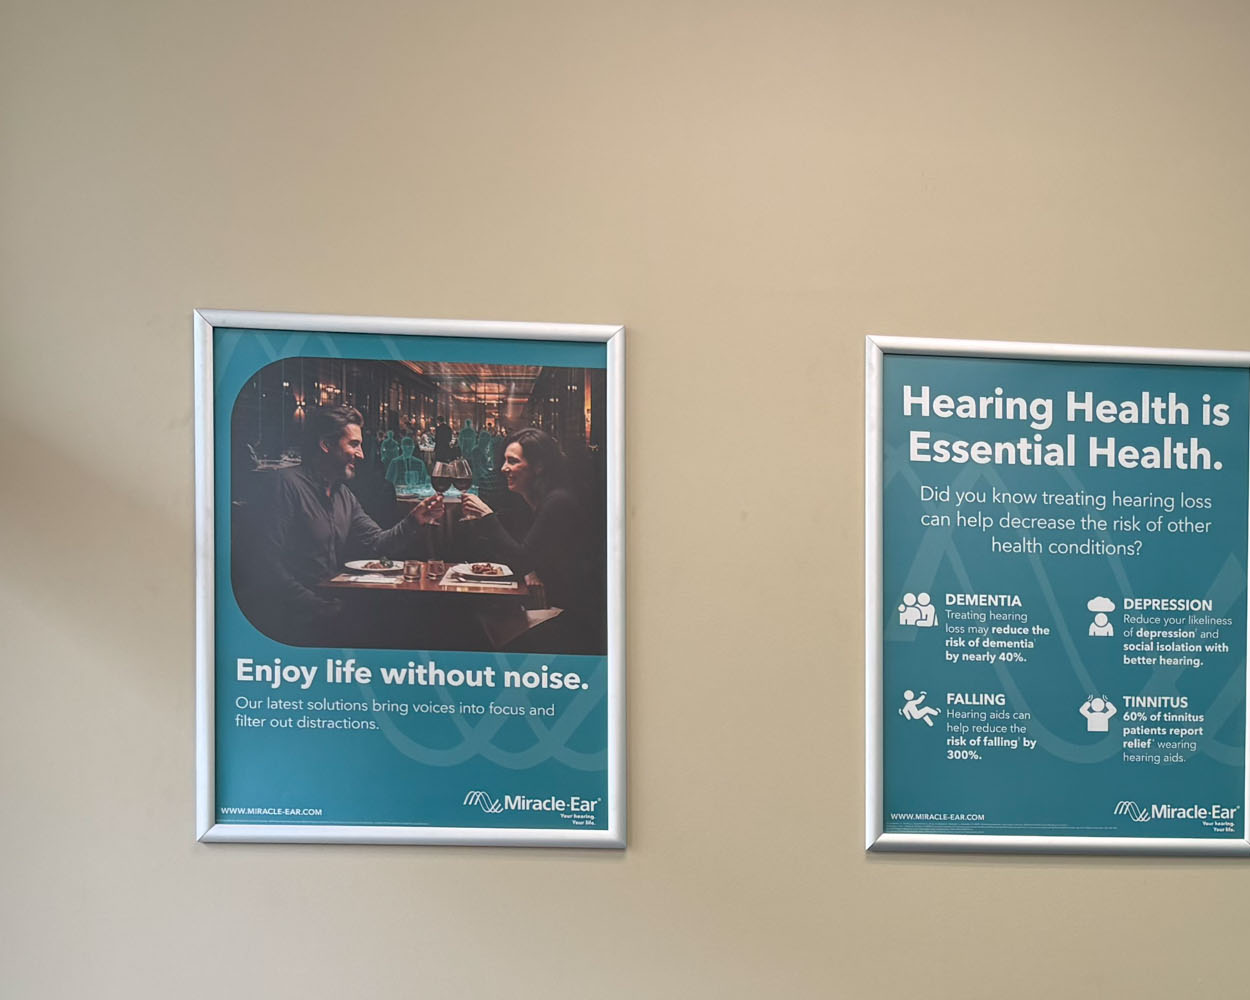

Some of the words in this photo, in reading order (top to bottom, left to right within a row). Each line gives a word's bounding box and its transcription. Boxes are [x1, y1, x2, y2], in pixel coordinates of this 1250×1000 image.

[904, 386, 1052, 430] Hearing
[1067, 391, 1189, 424] Health
[1203, 394, 1229, 426] is
[910, 431, 1075, 466] Essential
[1090, 437, 1222, 470] Health.
[921, 486, 949, 501] Did
[956, 492, 985, 506] you
[993, 487, 1037, 504] know
[1042, 491, 1106, 510] treating
[1113, 491, 1174, 512] hearing
[1181, 492, 1211, 508] loss
[921, 515, 950, 526] can
[957, 511, 993, 531] help
[1000, 512, 1075, 529] decrease
[1081, 514, 1107, 530] the
[1114, 515, 1140, 531] risk
[1146, 516, 1163, 531] of
[1168, 517, 1211, 532] other
[992, 536, 1042, 553] health
[1049, 539, 1142, 555] conditions?
[946, 594, 1022, 606] DEMENTIA
[1124, 598, 1212, 611] DEPRESSION
[945, 610, 986, 622] Treating
[990, 611, 1027, 623] hearing
[1124, 614, 1160, 624] Reduce
[1164, 618, 1185, 626] your
[1189, 615, 1232, 625] likeliness
[946, 623, 965, 633] loss
[968, 627, 988, 636] may
[992, 624, 1029, 634] reduce
[1032, 625, 1049, 635] the
[1123, 627, 1133, 637] of
[1136, 628, 1195, 640] depression
[1200, 629, 1218, 638] and
[946, 637, 965, 647] risk
[968, 638, 980, 647] of
[982, 638, 1034, 648] dementia
[1124, 642, 1153, 651] social
[1157, 642, 1202, 651] isolation
[1205, 643, 1228, 652] with
[946, 651, 959, 663] by
[962, 652, 996, 663] nearly
[999, 653, 1026, 662] 40%.
[1124, 655, 1157, 664] better
[1160, 655, 1203, 668] hearing.
[237, 658, 317, 689] Enjoy
[327, 659, 372, 683] life
[380, 661, 495, 687] without
[505, 665, 588, 689] noise.
[947, 693, 1005, 705] FALLING
[1123, 696, 1188, 708] TINNITUS
[236, 697, 263, 709] Our
[267, 697, 303, 710] latest
[308, 698, 368, 711] solutions
[373, 699, 408, 715] bring
[413, 701, 455, 713] voices
[460, 702, 484, 714] into
[489, 702, 525, 715] focus
[529, 704, 554, 716] and
[947, 709, 986, 721] Hearing
[990, 710, 1010, 719] aids
[1123, 712, 1147, 721] 60%
[1150, 712, 1161, 721] of
[1164, 712, 1204, 722] tinnitus
[235, 714, 266, 727] filter
[270, 718, 293, 727] out
[297, 716, 379, 729] distractions.
[947, 723, 969, 734] help
[972, 723, 1007, 733] reduce
[1010, 724, 1026, 733] the
[1123, 726, 1166, 736] patients
[1170, 727, 1203, 737] report
[947, 736, 966, 745] risk
[969, 736, 981, 746] of
[983, 736, 1017, 749] falling
[1023, 737, 1036, 749] by
[1123, 739, 1151, 748] relief
[1158, 742, 1196, 751] wearing
[947, 750, 981, 759] 300%.
[1123, 752, 1160, 764] hearing
[1164, 753, 1186, 762] aids.
